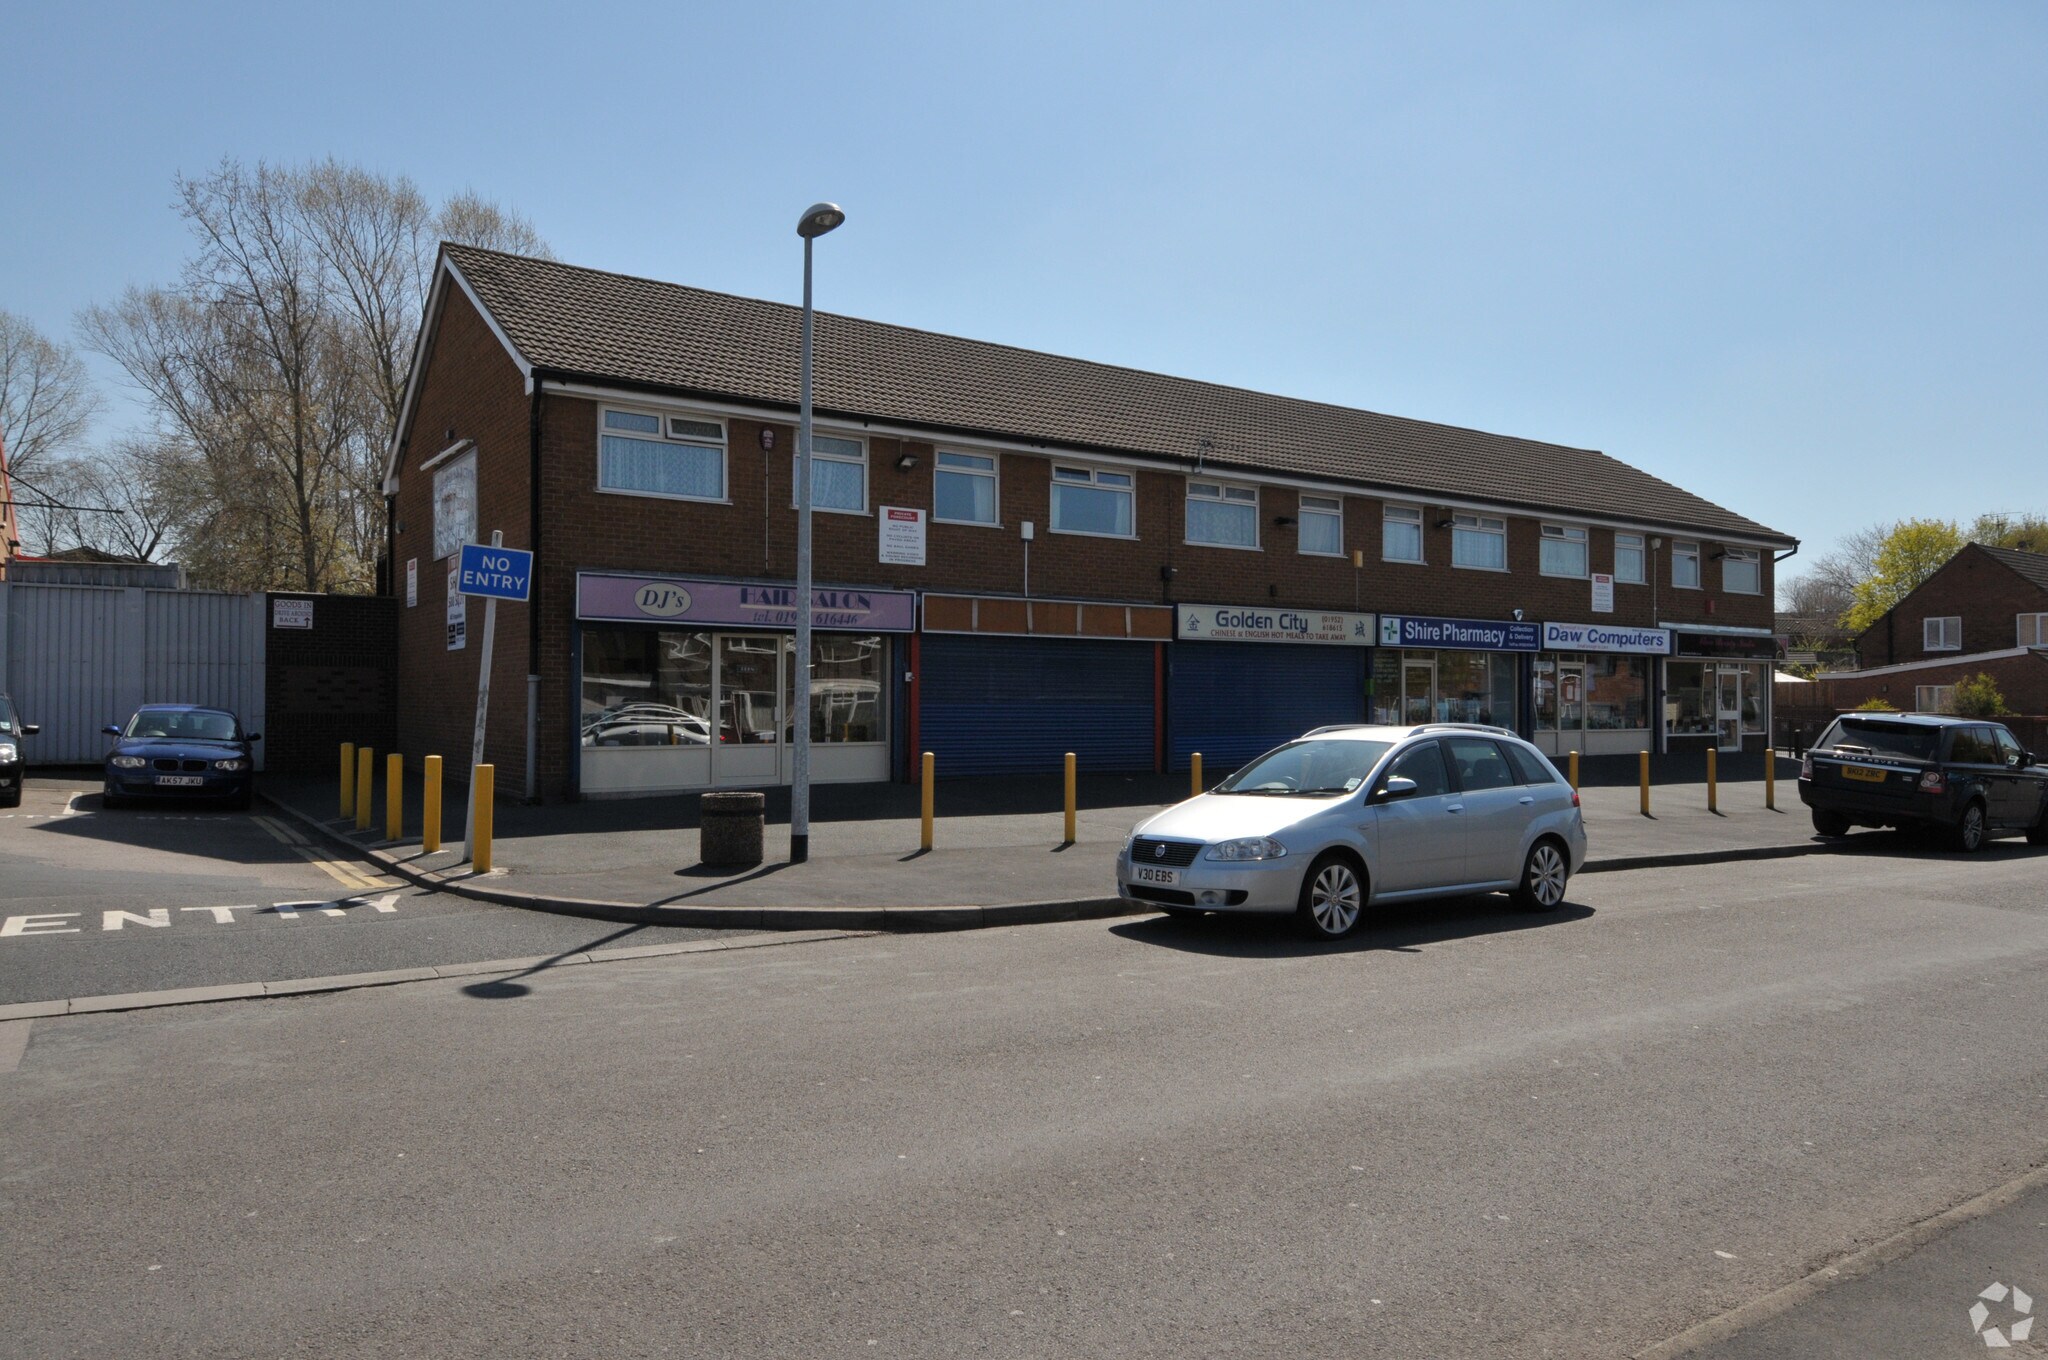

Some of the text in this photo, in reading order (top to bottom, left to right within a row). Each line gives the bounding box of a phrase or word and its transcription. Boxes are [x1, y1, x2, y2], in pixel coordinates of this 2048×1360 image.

[482, 555, 510, 572] NO
[463, 570, 525, 591] ENTRY
[274, 600, 302, 608] GOODS
[642, 589, 684, 609] DJ's
[740, 587, 871, 610] HAIR ALON
[753, 612, 771, 622] tel.
[816, 613, 858, 625] 616446
[1186, 613, 1200, 632] 金
[1215, 610, 1309, 633] Golden City
[1321, 615, 1344, 624] (01952)
[1210, 629, 1237, 638] CHINESE
[1245, 630, 1270, 639] ENGLISH
[1271, 631, 1284, 639] HOT
[1286, 632, 1305, 640] MEALS
[1315, 633, 1329, 641] TAKE
[1330, 633, 1347, 641] AWAY
[1405, 621, 1506, 648] Shire Pharmacy
[1514, 633, 1534, 642] Delivery
[1548, 626, 1583, 642] Daw
[1587, 629, 1664, 648] Computers
[1867, 758, 1899, 766] ROVER
[161, 777, 202, 785] AK57 JKU
[1138, 867, 1173, 883] V30 EBS
[0, 894, 402, 938] ENTRY
